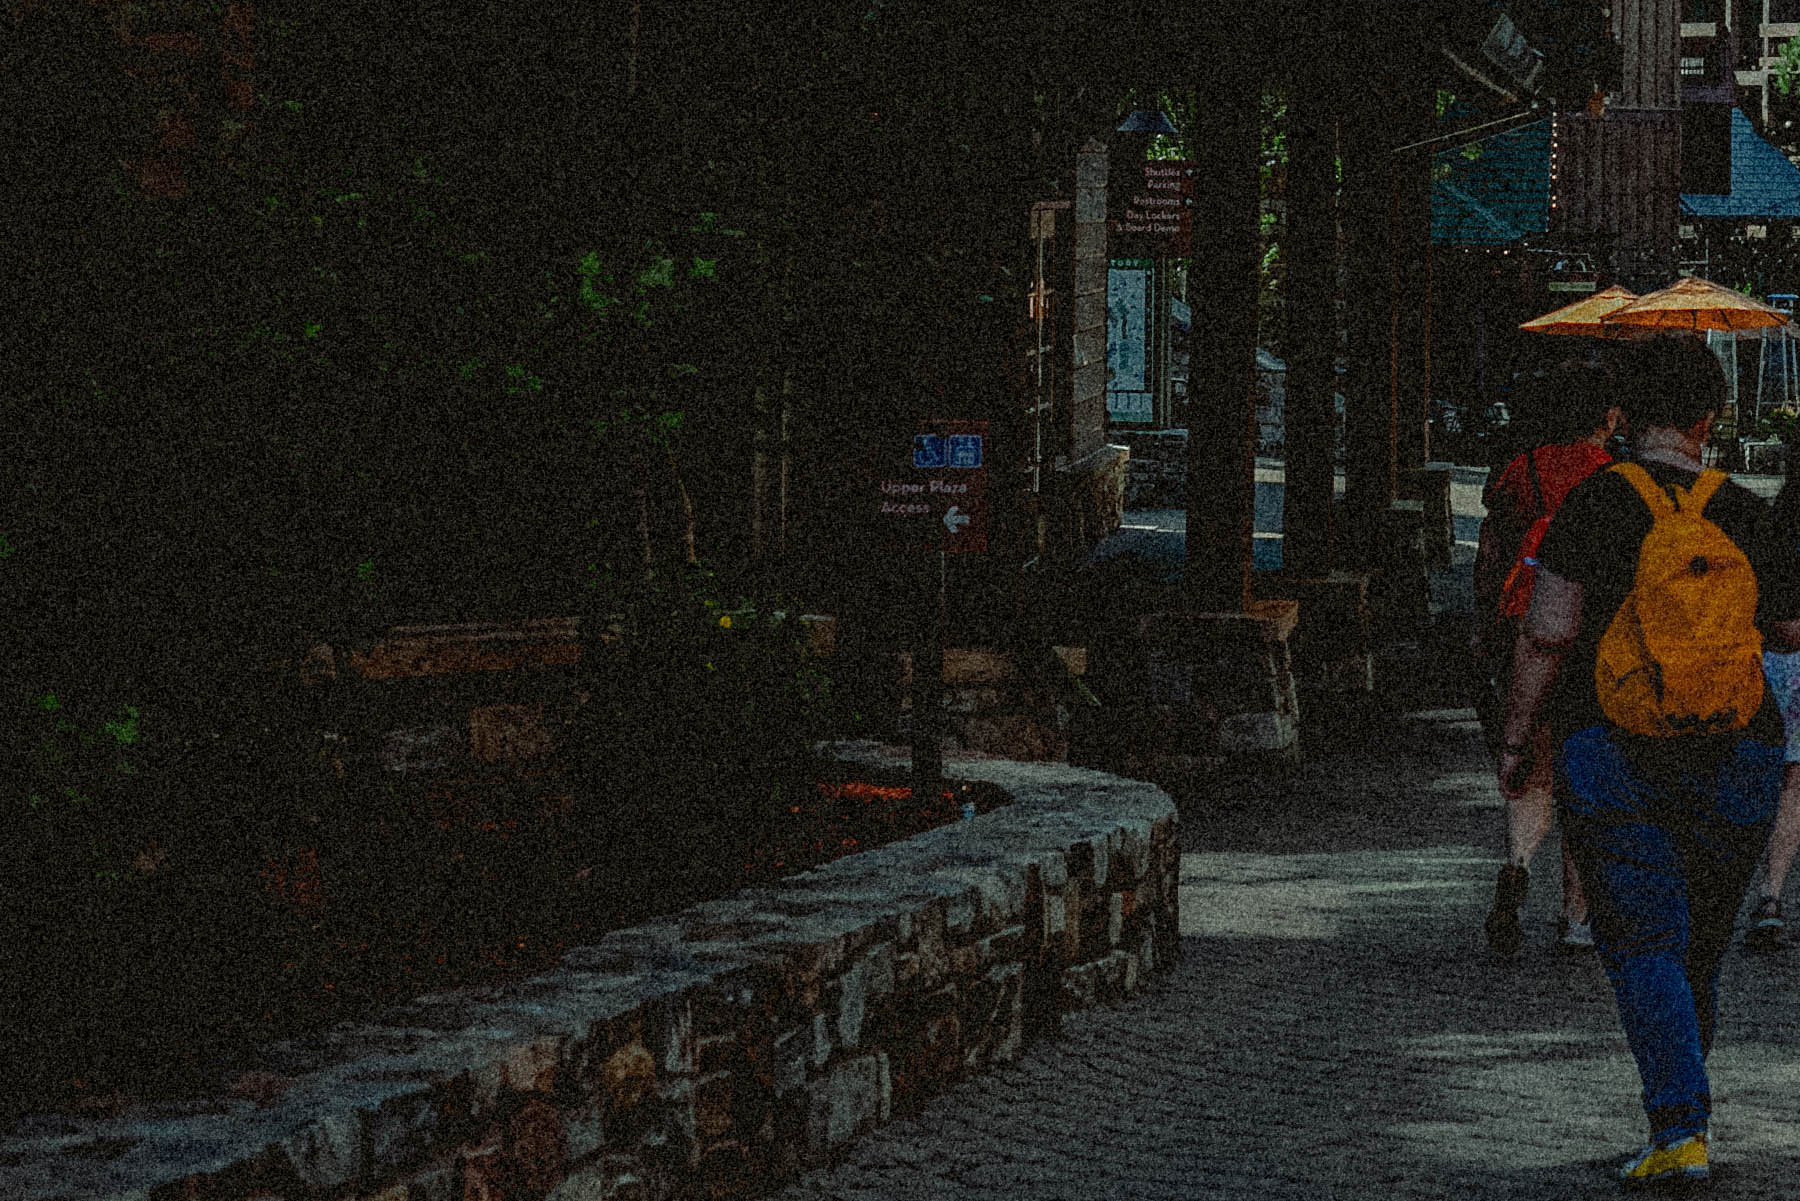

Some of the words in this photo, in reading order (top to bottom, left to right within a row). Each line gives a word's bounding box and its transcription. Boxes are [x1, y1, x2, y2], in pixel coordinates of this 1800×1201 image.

[1144, 167, 1181, 177] Shuttles
[1147, 179, 1181, 192] Parking
[1133, 195, 1181, 206] Restrooms
[1126, 209, 1144, 222] Day
[1145, 209, 1181, 220] Lockers
[880, 479, 925, 496] Upper
[928, 478, 968, 494] Plaza
[881, 501, 931, 514] Access
